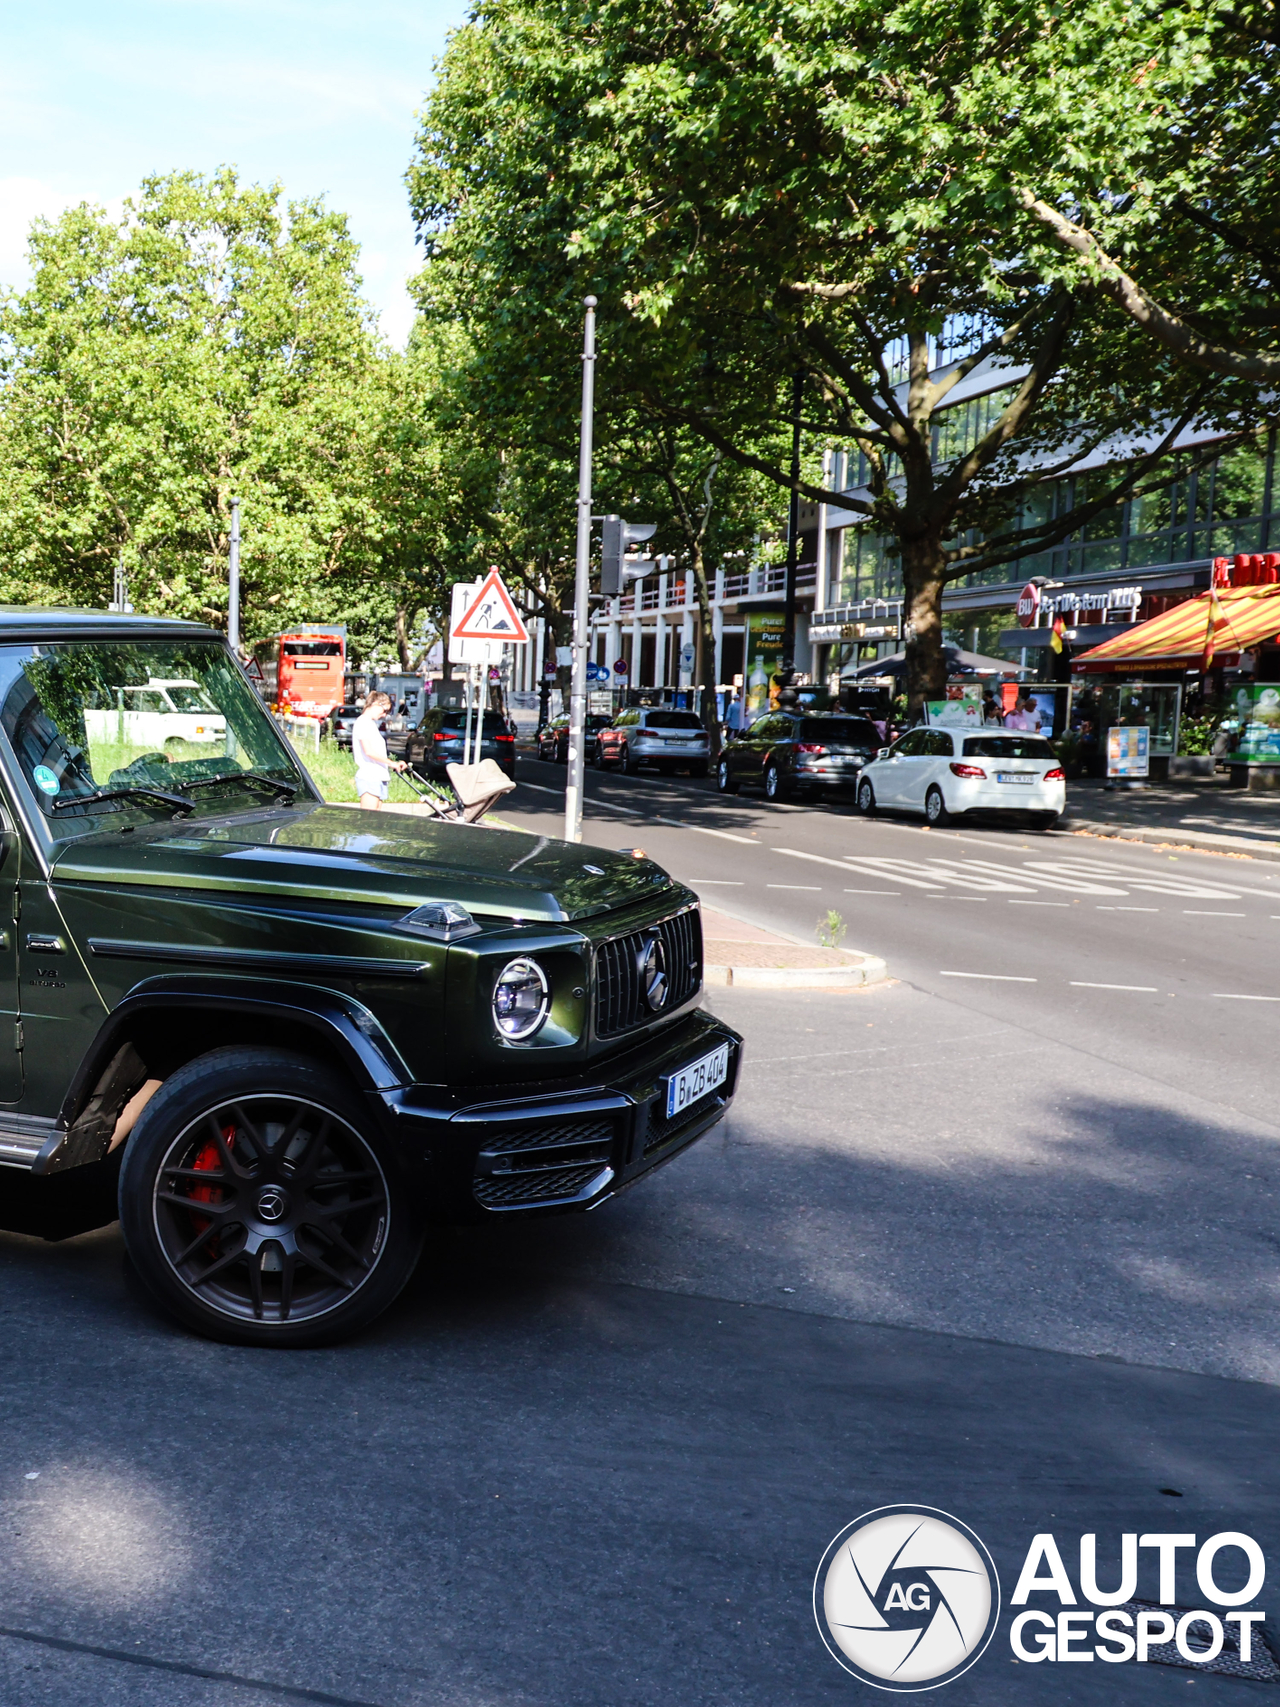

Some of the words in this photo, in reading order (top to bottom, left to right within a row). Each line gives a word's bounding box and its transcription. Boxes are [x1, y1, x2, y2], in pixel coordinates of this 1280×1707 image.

[1017, 597, 1034, 616] BW
[761, 617, 783, 625] Purer
[762, 632, 781, 641] Pure
[36, 968, 59, 979] V8
[679, 1076, 686, 1106] B
[692, 1064, 705, 1098] ZB
[707, 1051, 725, 1086] 404
